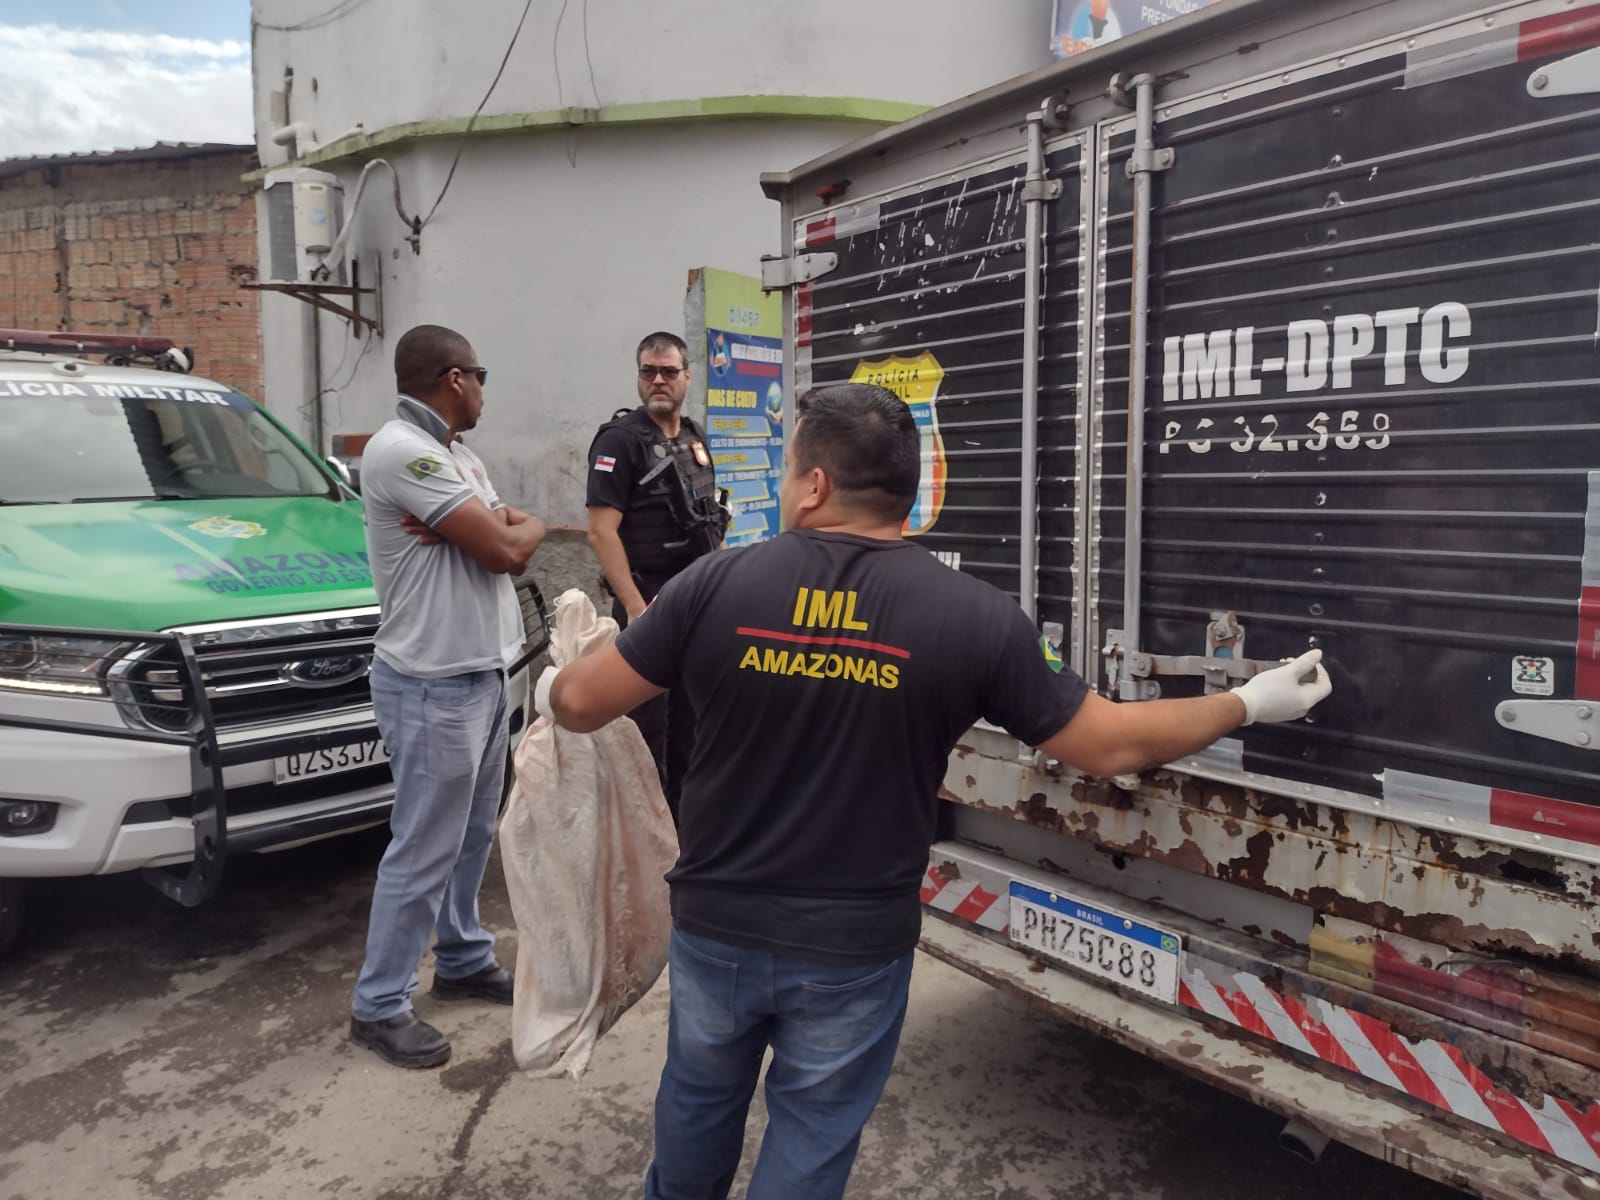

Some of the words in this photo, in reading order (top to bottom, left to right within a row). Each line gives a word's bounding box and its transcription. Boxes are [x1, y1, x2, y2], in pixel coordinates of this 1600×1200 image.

[1163, 301, 1472, 402] IML-DPTC
[868, 368, 919, 384] POLÍCIA
[91, 384, 230, 406] MILITAR
[208, 572, 306, 593] GOVERNO
[309, 570, 339, 584] DO
[341, 567, 371, 582] EST
[792, 587, 868, 631] IML
[310, 658, 352, 677] Ford
[739, 646, 900, 689] AMAZONAS
[1076, 908, 1104, 926] BRASIL
